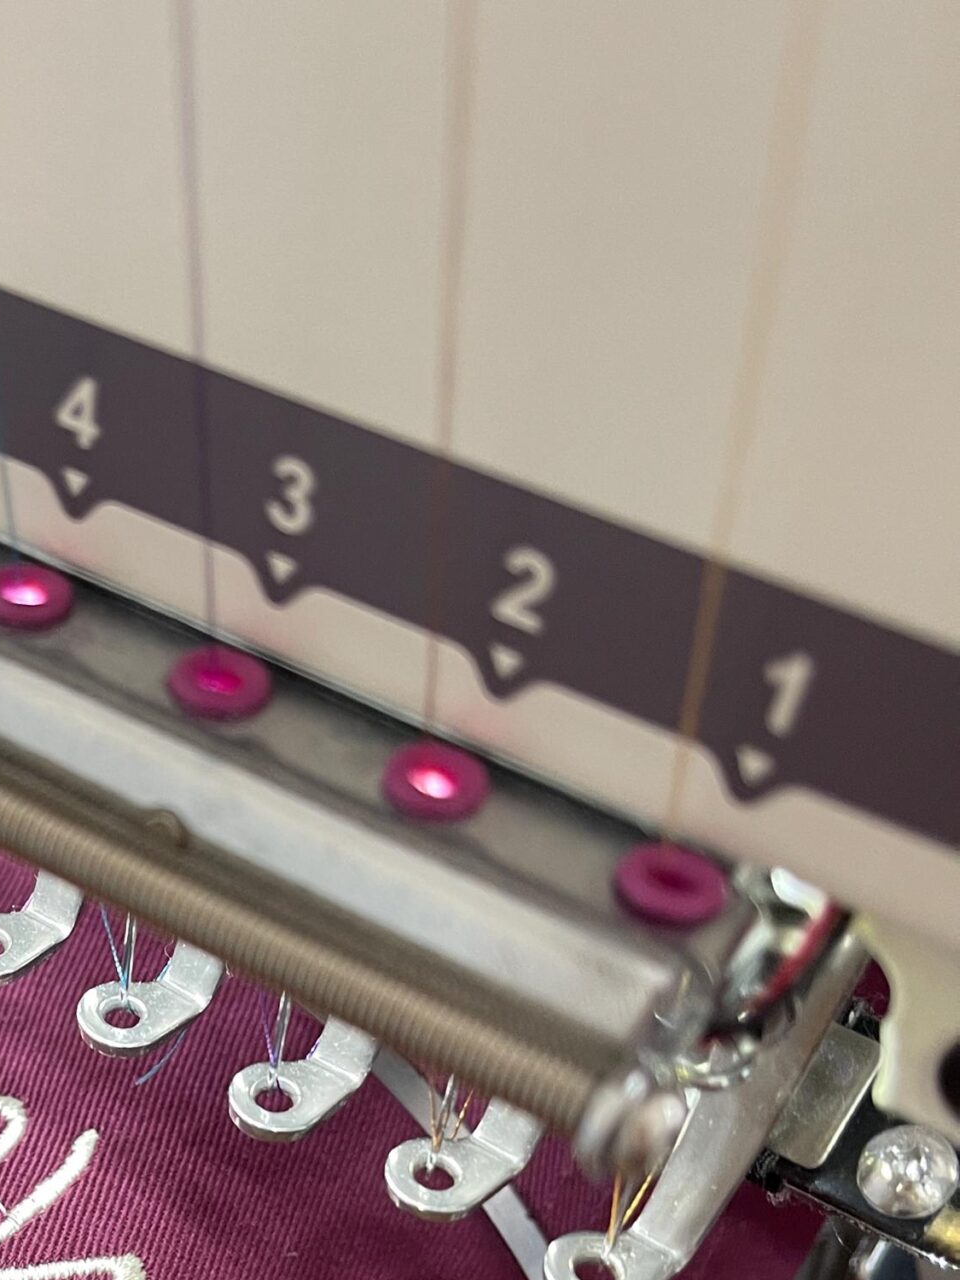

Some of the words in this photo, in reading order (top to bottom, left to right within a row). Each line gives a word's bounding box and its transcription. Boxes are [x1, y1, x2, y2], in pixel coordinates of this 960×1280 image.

[56, 377, 101, 449] 4
[266, 456, 315, 534] 3
[492, 547, 554, 634] 2
[766, 653, 813, 735] 1
